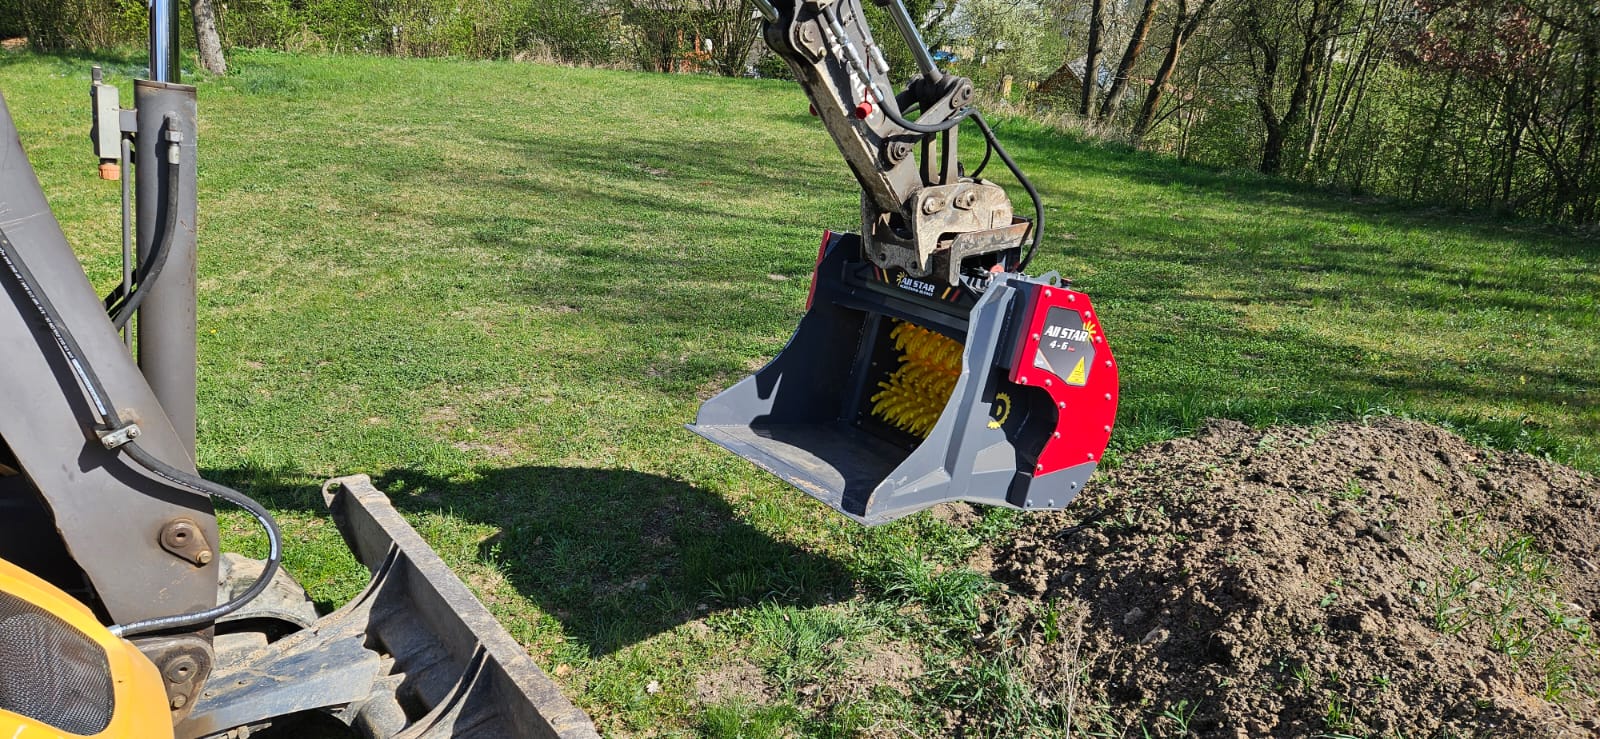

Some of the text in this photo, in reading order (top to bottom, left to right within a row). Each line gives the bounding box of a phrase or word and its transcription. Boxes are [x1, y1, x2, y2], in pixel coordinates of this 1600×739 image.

[913, 280, 935, 292] STAR
[1044, 325, 1088, 341] All STAR
